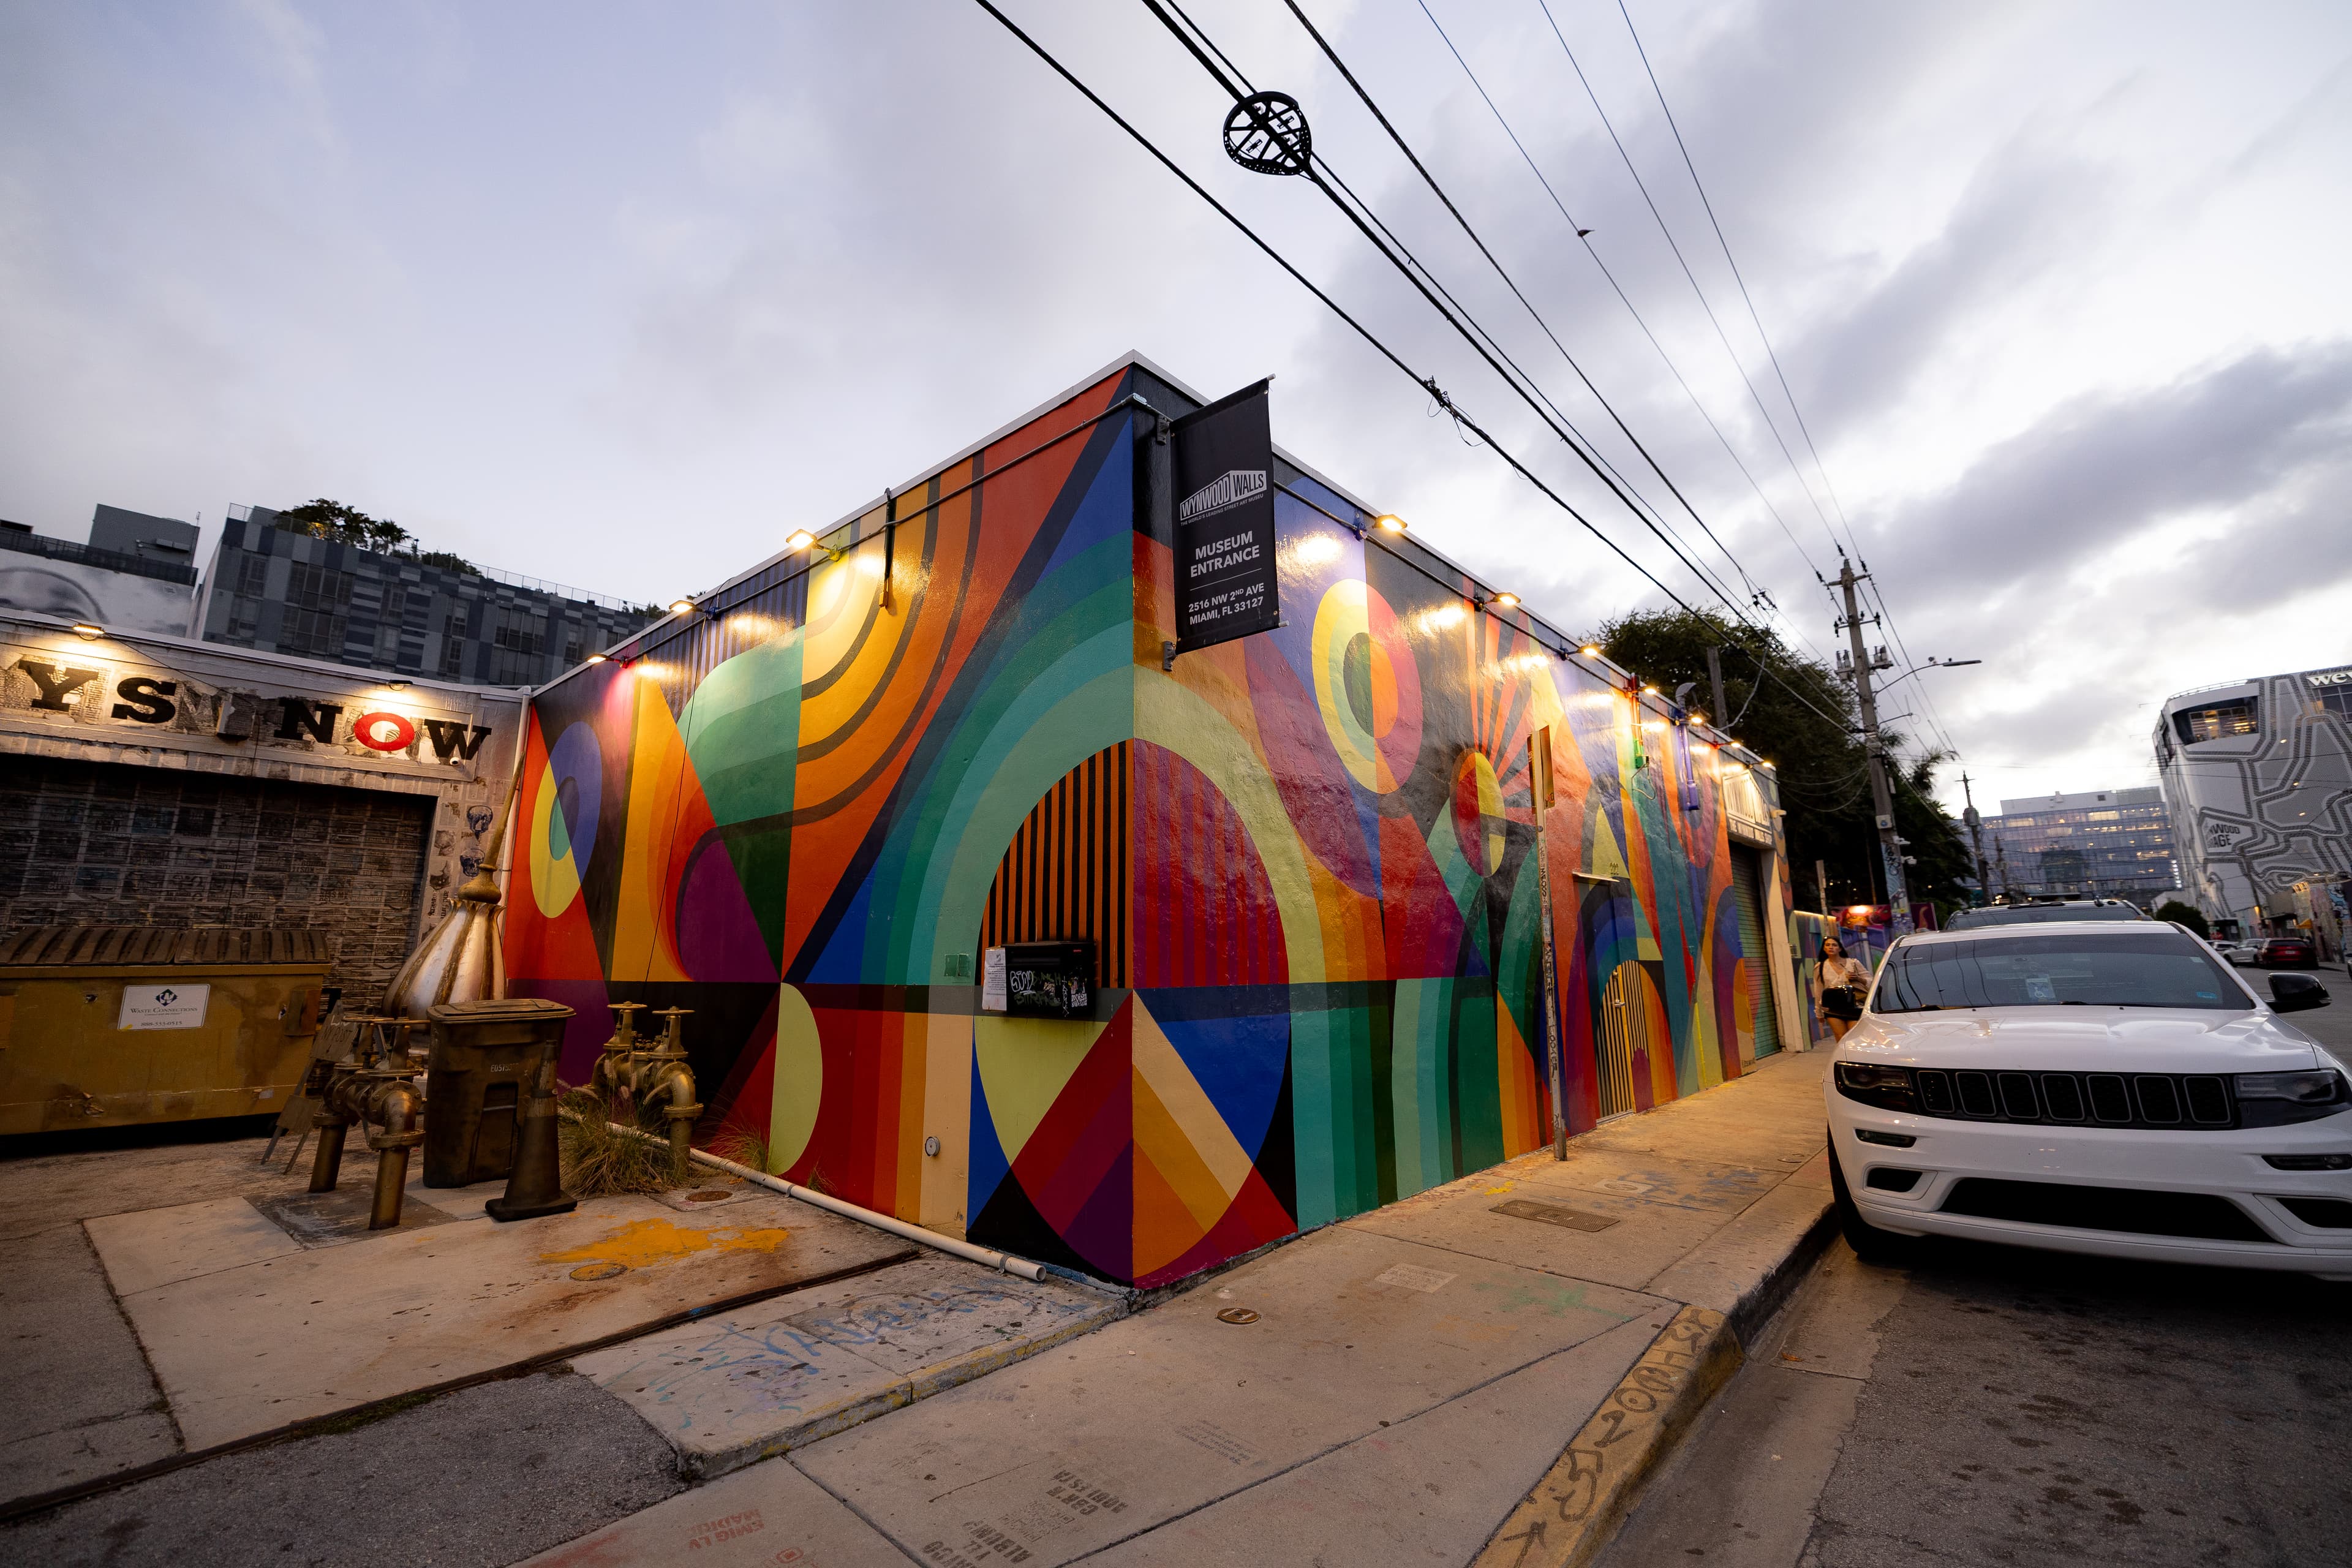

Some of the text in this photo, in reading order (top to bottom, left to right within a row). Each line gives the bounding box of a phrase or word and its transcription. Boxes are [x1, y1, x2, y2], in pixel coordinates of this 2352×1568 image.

[1182, 473, 1264, 517] WYNWOOD WALLS
[1188, 514, 1205, 524] WORLD'S
[1205, 508, 1224, 518] LEADING
[1224, 502, 1239, 511] STREET
[1248, 493, 1264, 502] MUSEU
[1196, 530, 1253, 560] MUSEUM
[1191, 545, 1260, 578] ENTRANCE
[1188, 582, 1264, 612] 2516 NW 2ND AVE
[1189, 596, 1264, 625] MIAMI, FL 33127
[2307, 671, 2352, 686] we
[274, 696, 492, 760] NOW
